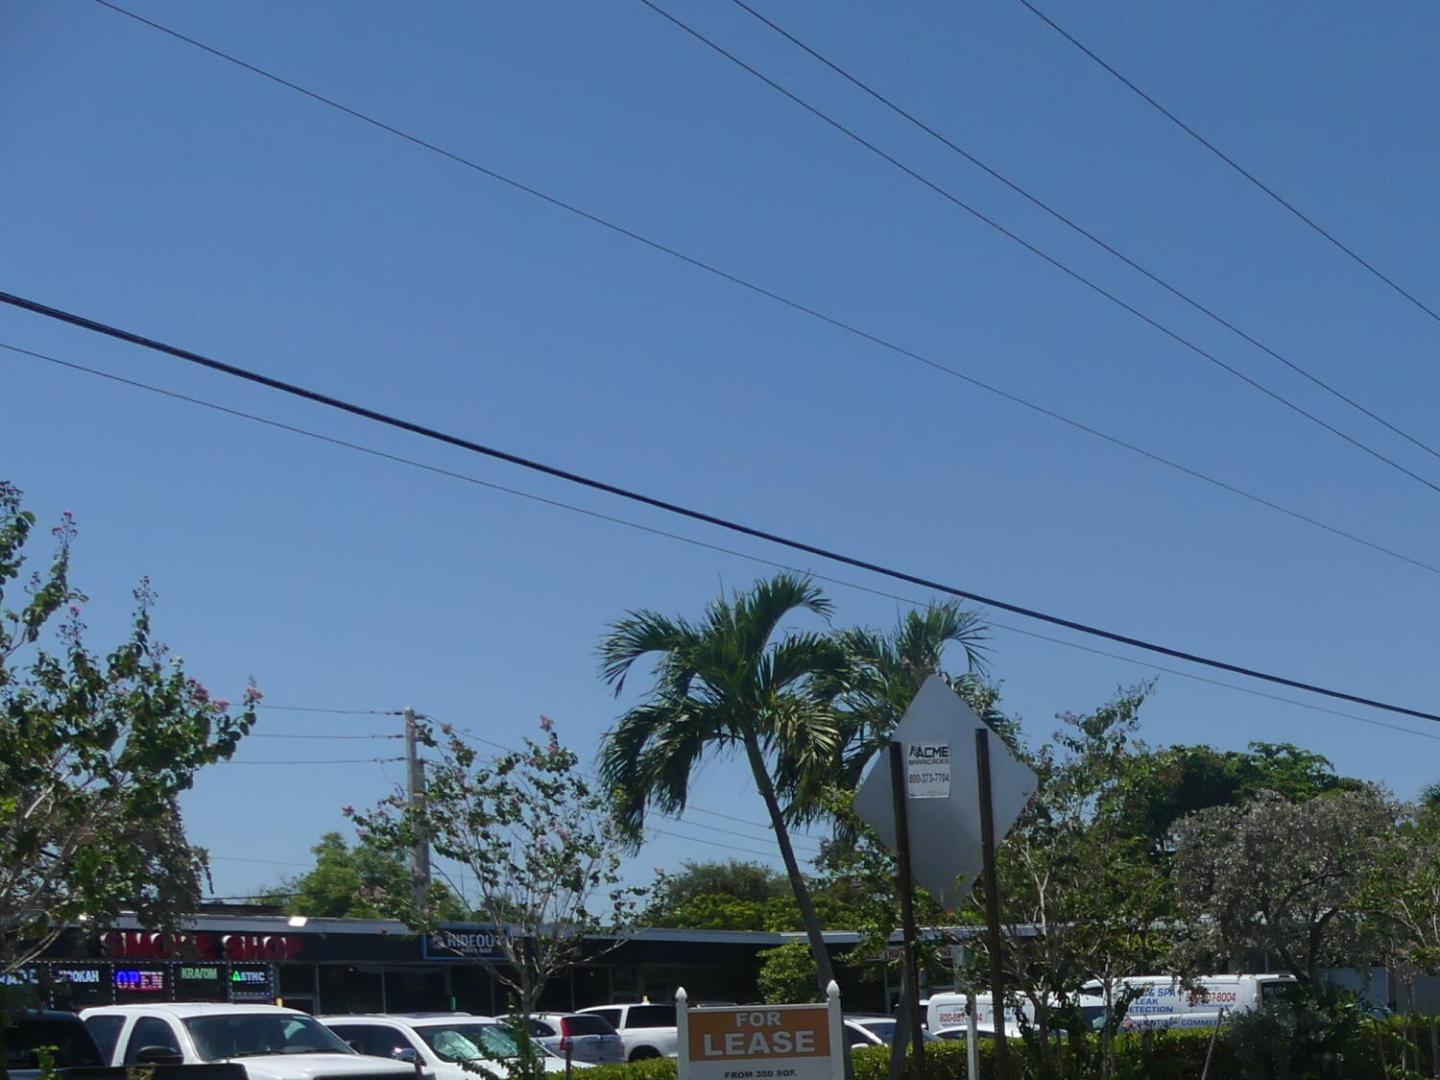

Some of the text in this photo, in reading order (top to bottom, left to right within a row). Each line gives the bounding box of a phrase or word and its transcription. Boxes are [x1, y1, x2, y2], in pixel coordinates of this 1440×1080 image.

[447, 934, 502, 948] HIDEOU
[115, 971, 163, 990] OPEN
[736, 1011, 781, 1027] FOR
[703, 1030, 816, 1057] LEASE
[724, 1071, 753, 1079] FROM
